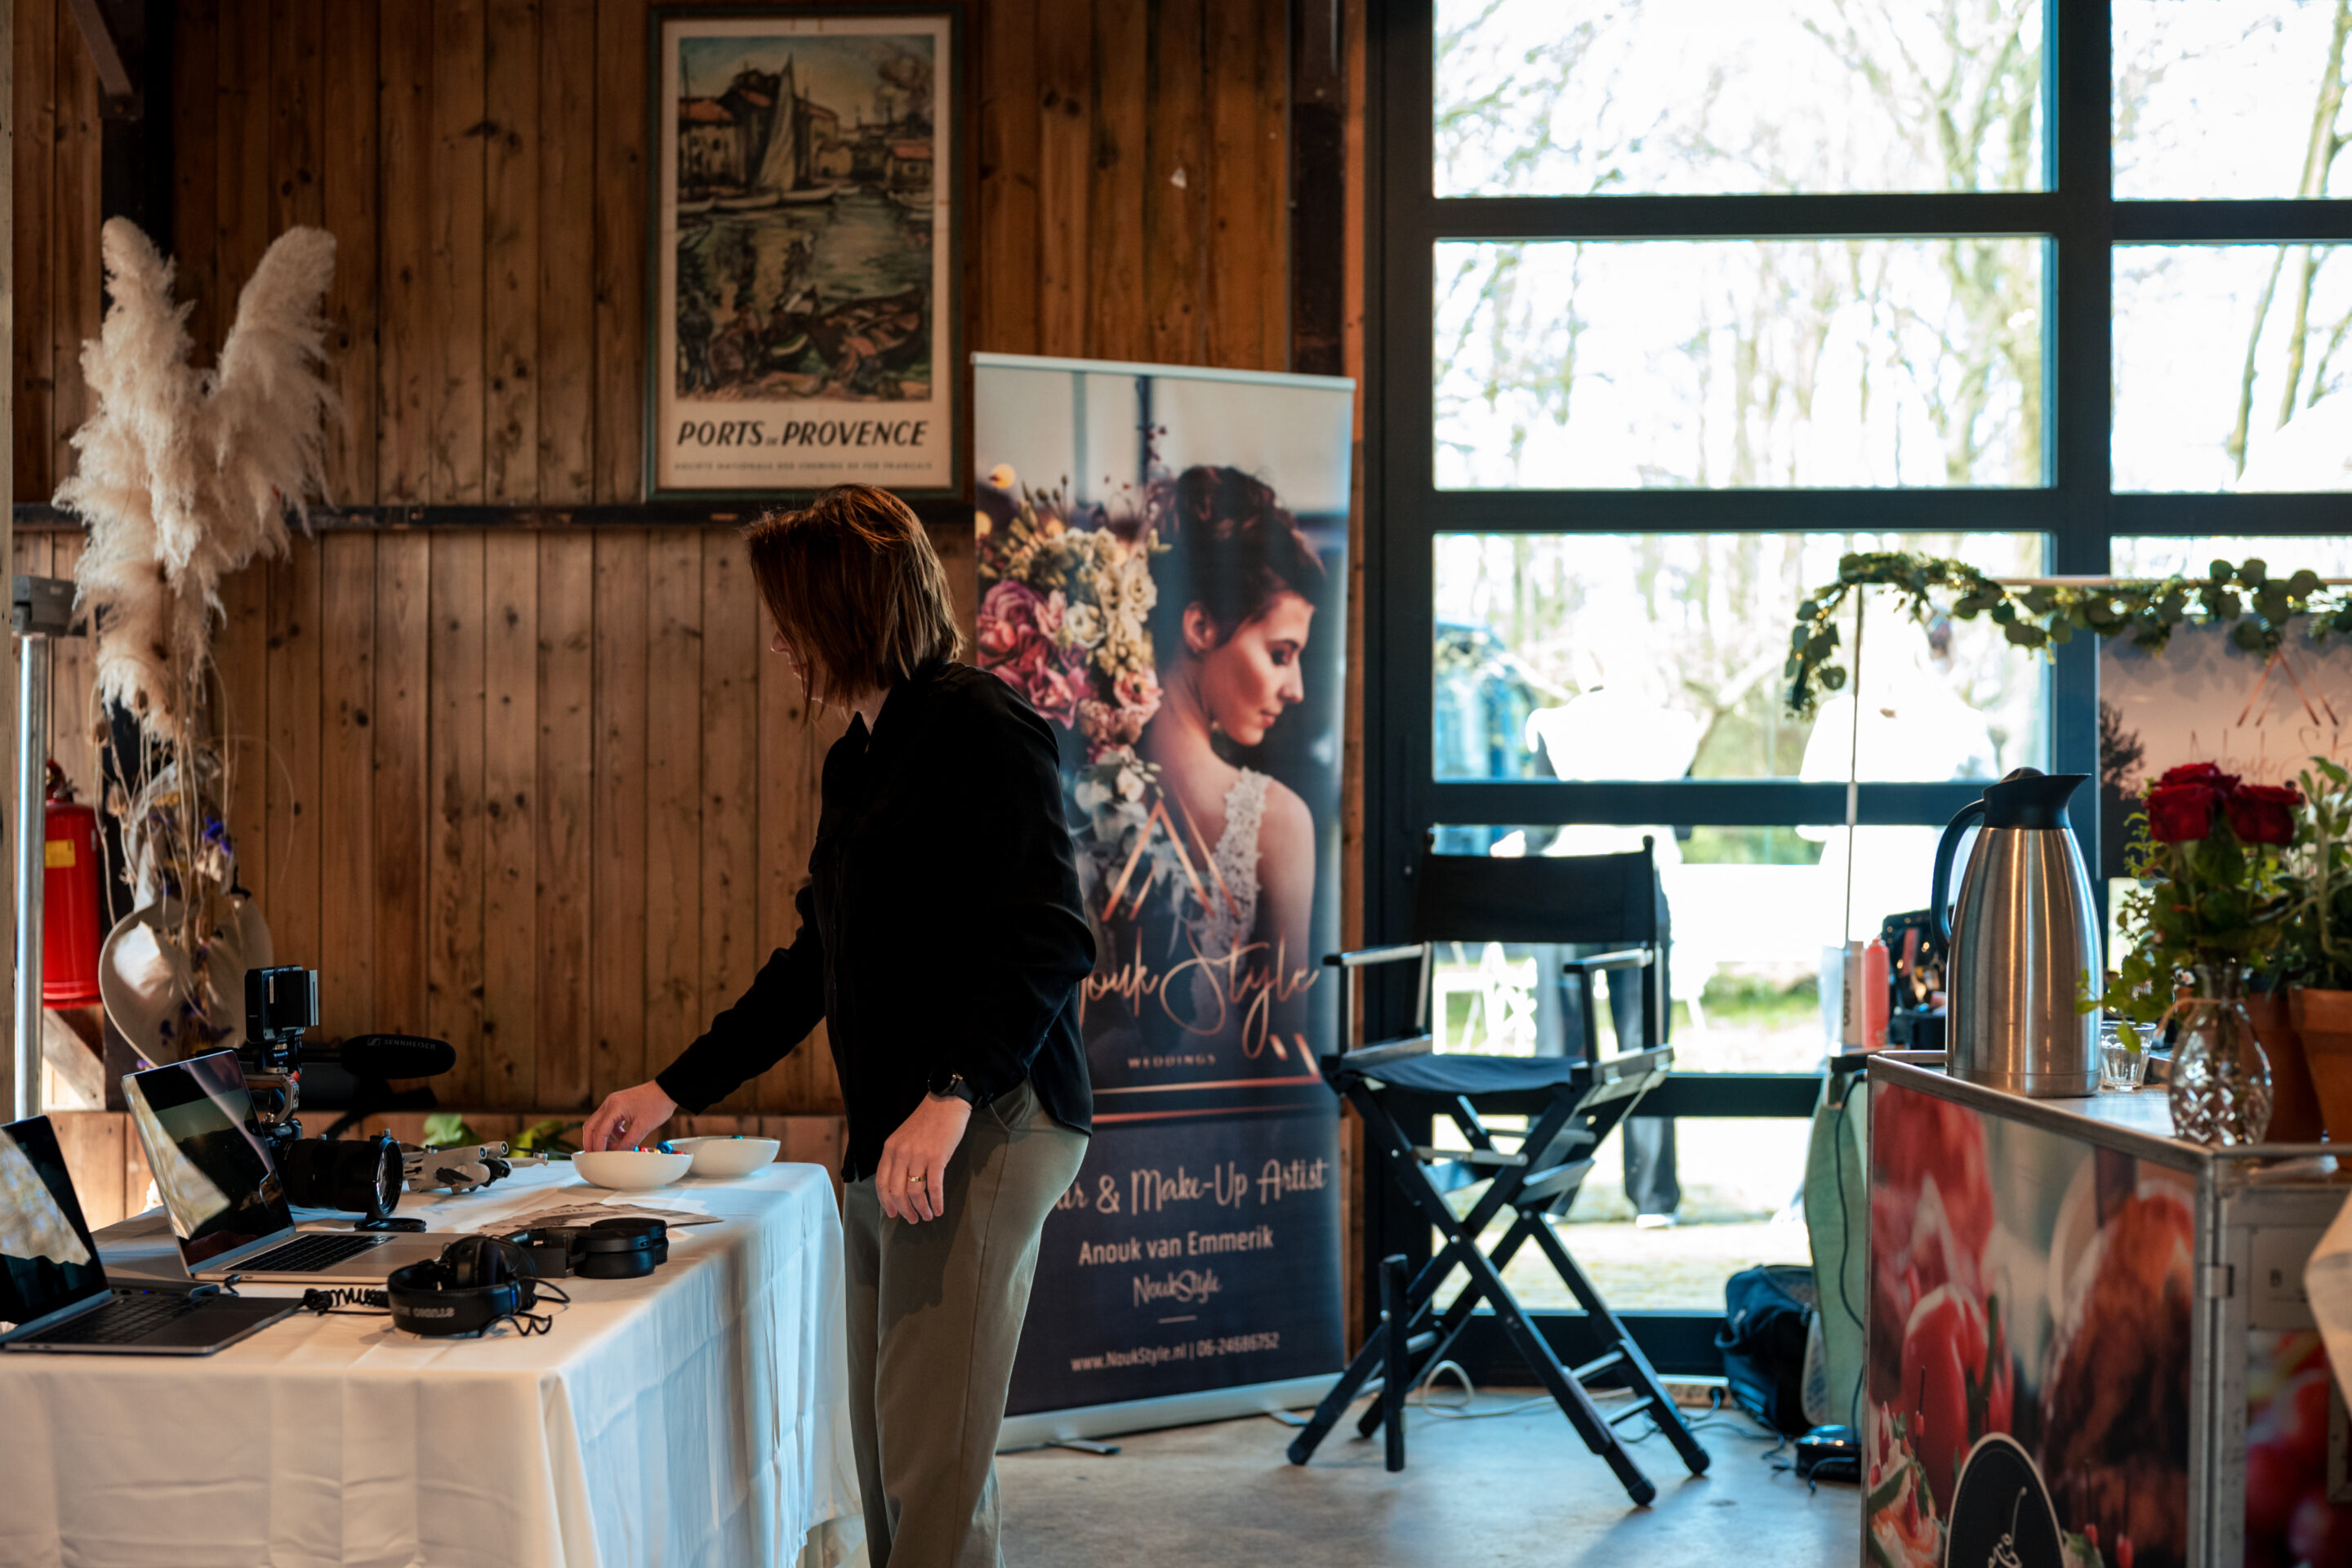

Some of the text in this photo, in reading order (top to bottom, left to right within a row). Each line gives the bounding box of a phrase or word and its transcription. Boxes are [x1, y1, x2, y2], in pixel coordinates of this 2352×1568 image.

[677, 420, 766, 447] PORTS
[782, 420, 929, 447] PROVENCE
[1079, 920, 1320, 1060] ouk Style
[383, 1039, 436, 1050] SENNHEISER
[1127, 1054, 1217, 1070] WEDDINGS
[1096, 1174, 1120, 1214] &
[1131, 1160, 1249, 1216] Make-Up
[1256, 1157, 1330, 1206] Artist
[1078, 1224, 1274, 1267] Anouk van Emmerik
[1134, 1268, 1223, 1307] NoukStyle
[1071, 1343, 1187, 1372] www.NoukStyle.nl
